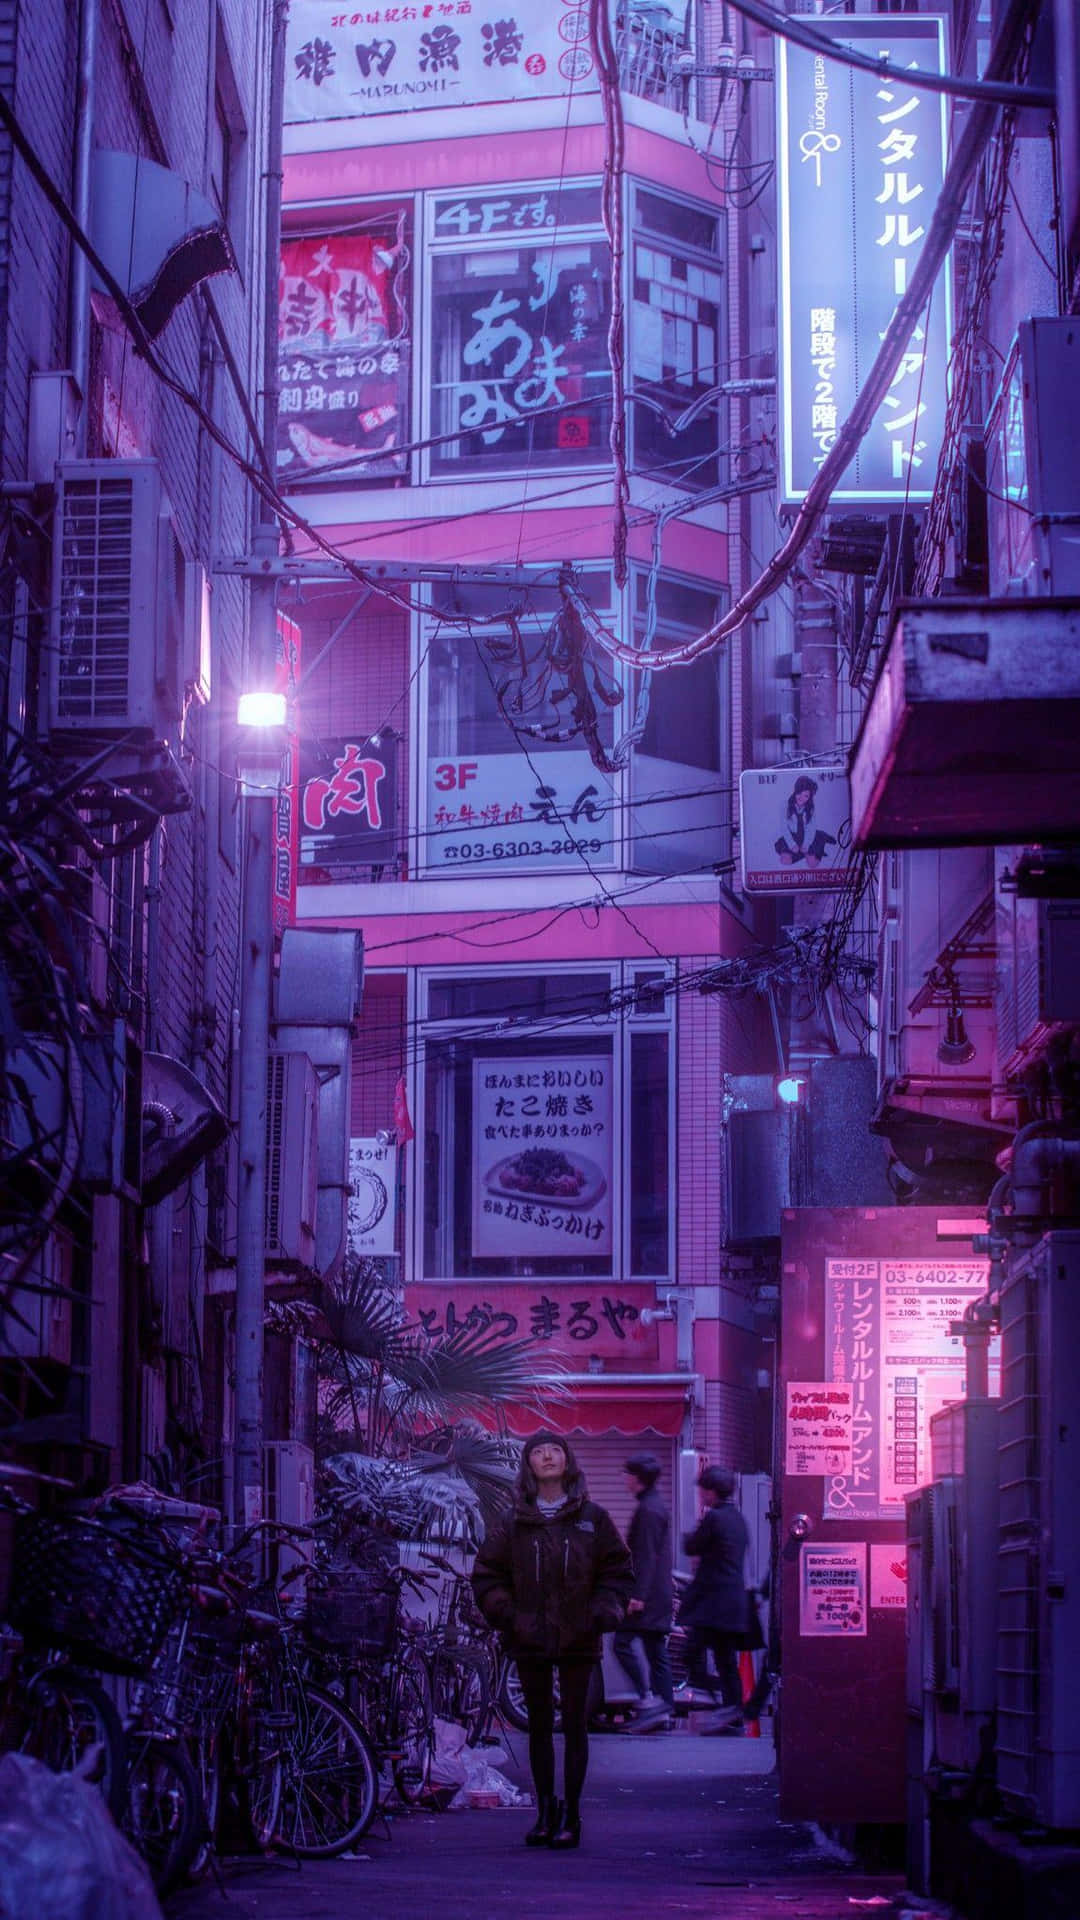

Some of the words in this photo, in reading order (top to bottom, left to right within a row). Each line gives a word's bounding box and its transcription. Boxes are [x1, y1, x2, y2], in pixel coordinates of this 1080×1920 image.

[814, 55, 824, 89] ental
[815, 91, 828, 130] Room
[436, 194, 556, 234] 4Fです。
[303, 744, 385, 830] 肉
[434, 763, 478, 791] 3F
[484, 1069, 604, 1089] ほんまにおいしい
[495, 1094, 594, 1117] たこ焼き
[530, 1295, 638, 1340] まるや
[851, 1281, 875, 1487] レンタルルームアンド
[880, 1596, 905, 1605] ENTER
